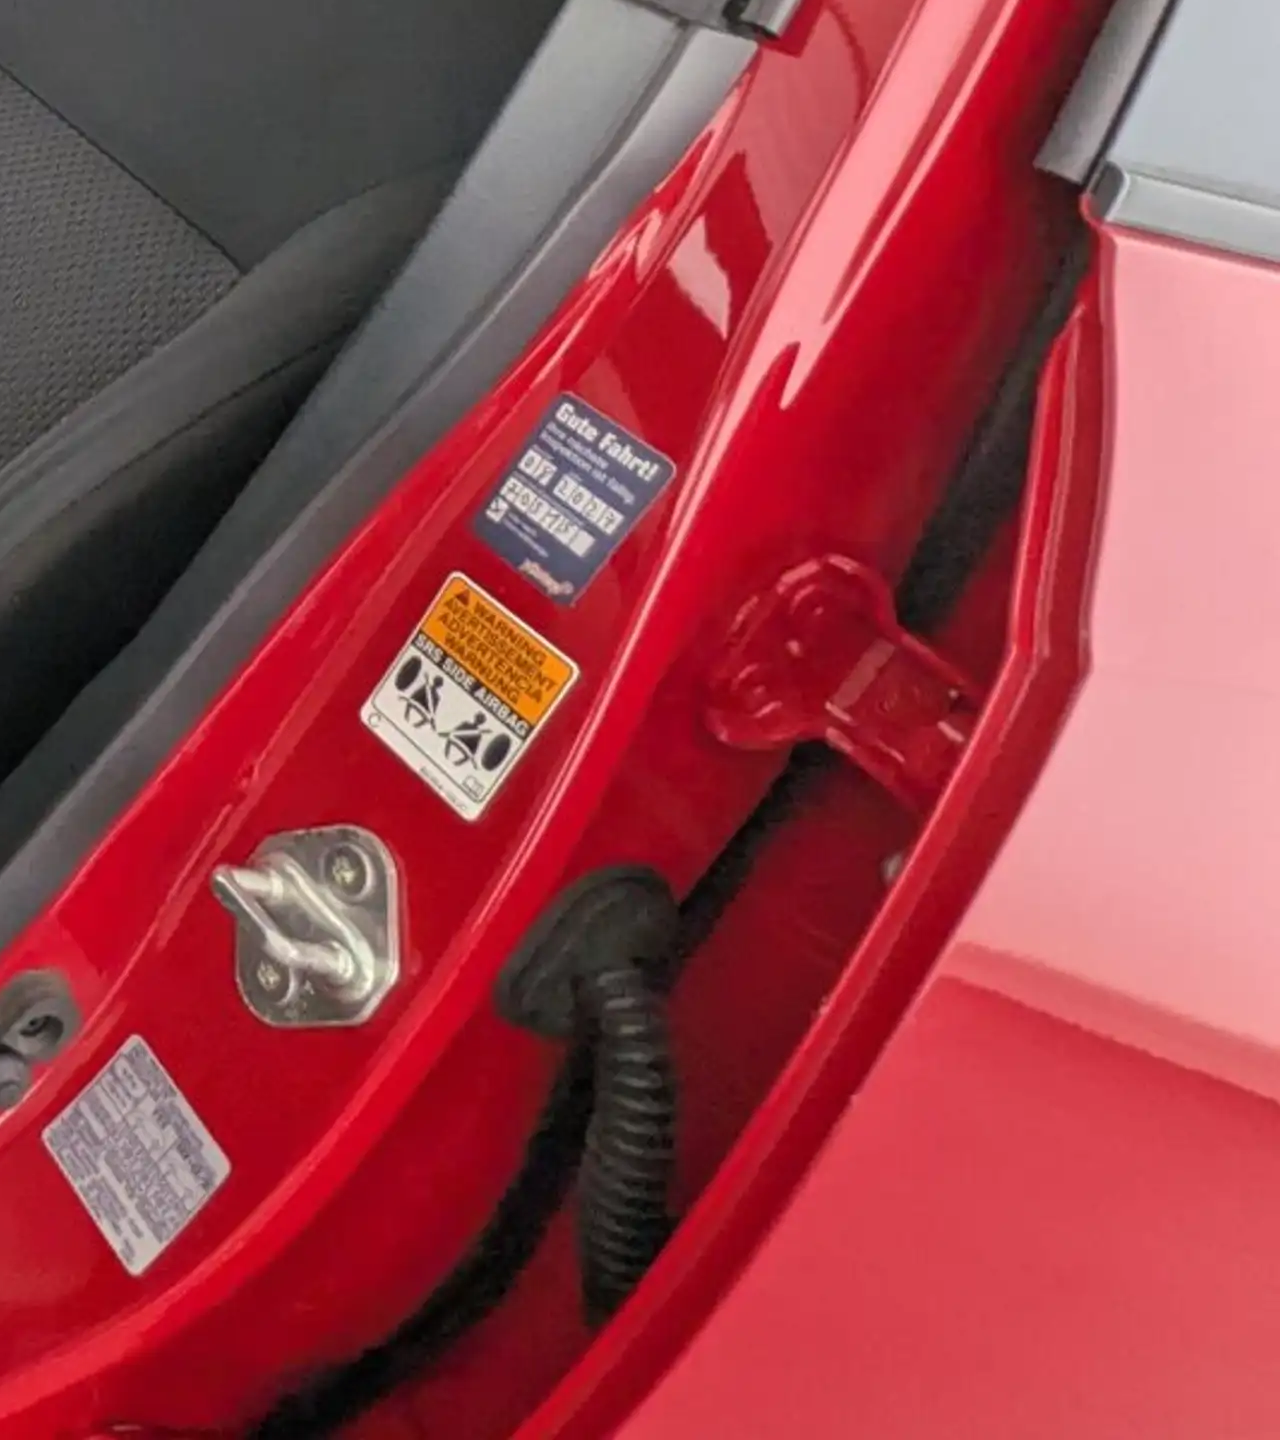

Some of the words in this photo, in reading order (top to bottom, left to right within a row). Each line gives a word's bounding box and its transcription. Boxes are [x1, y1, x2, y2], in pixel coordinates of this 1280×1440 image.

[555, 402, 599, 442] Gute
[598, 432, 660, 482] Fahrt!
[437, 613, 543, 704] ADVERTENCIA
[443, 598, 556, 692] AVERTISSEMENT
[443, 633, 520, 705] WARNUNG
[474, 602, 547, 667] WARNING
[414, 633, 443, 662] SRS
[442, 656, 476, 691] SIDE
[474, 686, 531, 737] AIRBAG
